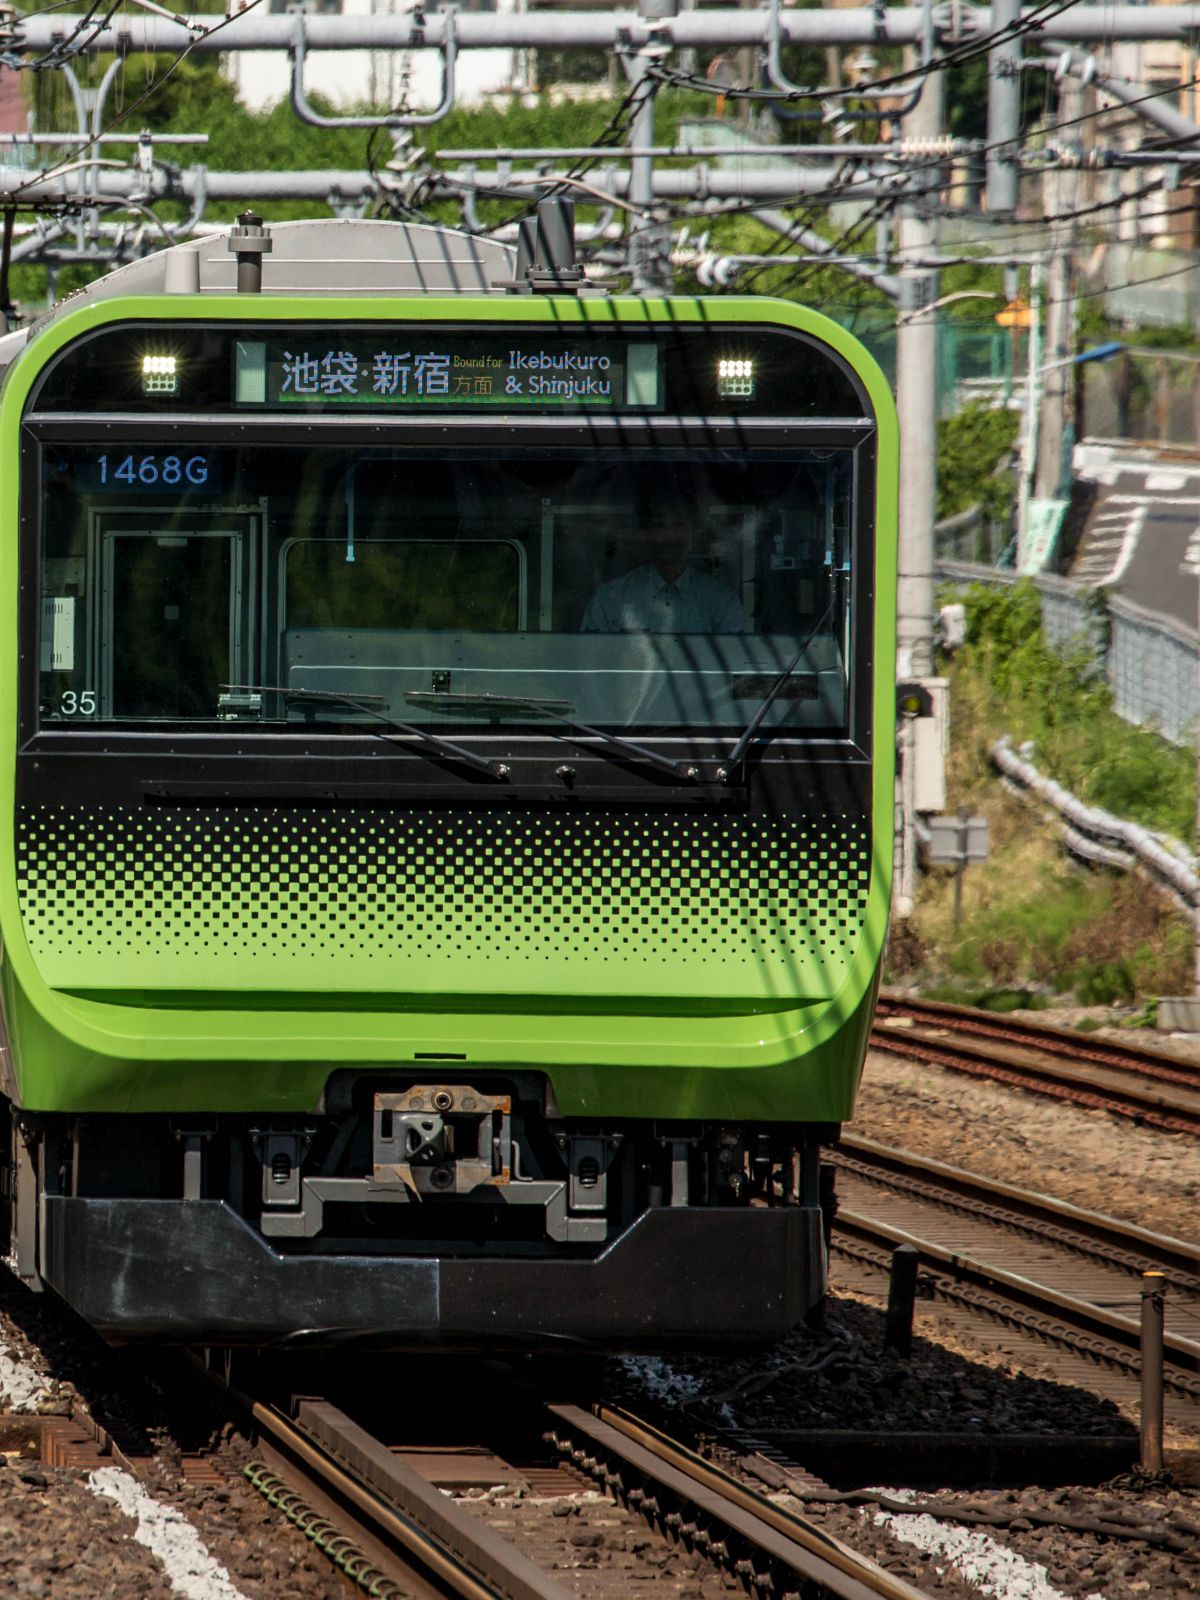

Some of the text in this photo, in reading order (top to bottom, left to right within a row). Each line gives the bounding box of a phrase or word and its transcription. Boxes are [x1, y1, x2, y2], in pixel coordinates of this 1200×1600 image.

[453, 355, 504, 368] Bound for
[509, 350, 611, 370] Ikebukuro
[452, 375, 494, 395] 方面
[505, 375, 611, 399] & Shinjuku
[97, 455, 209, 484] 1468G
[61, 690, 96, 715] 35
